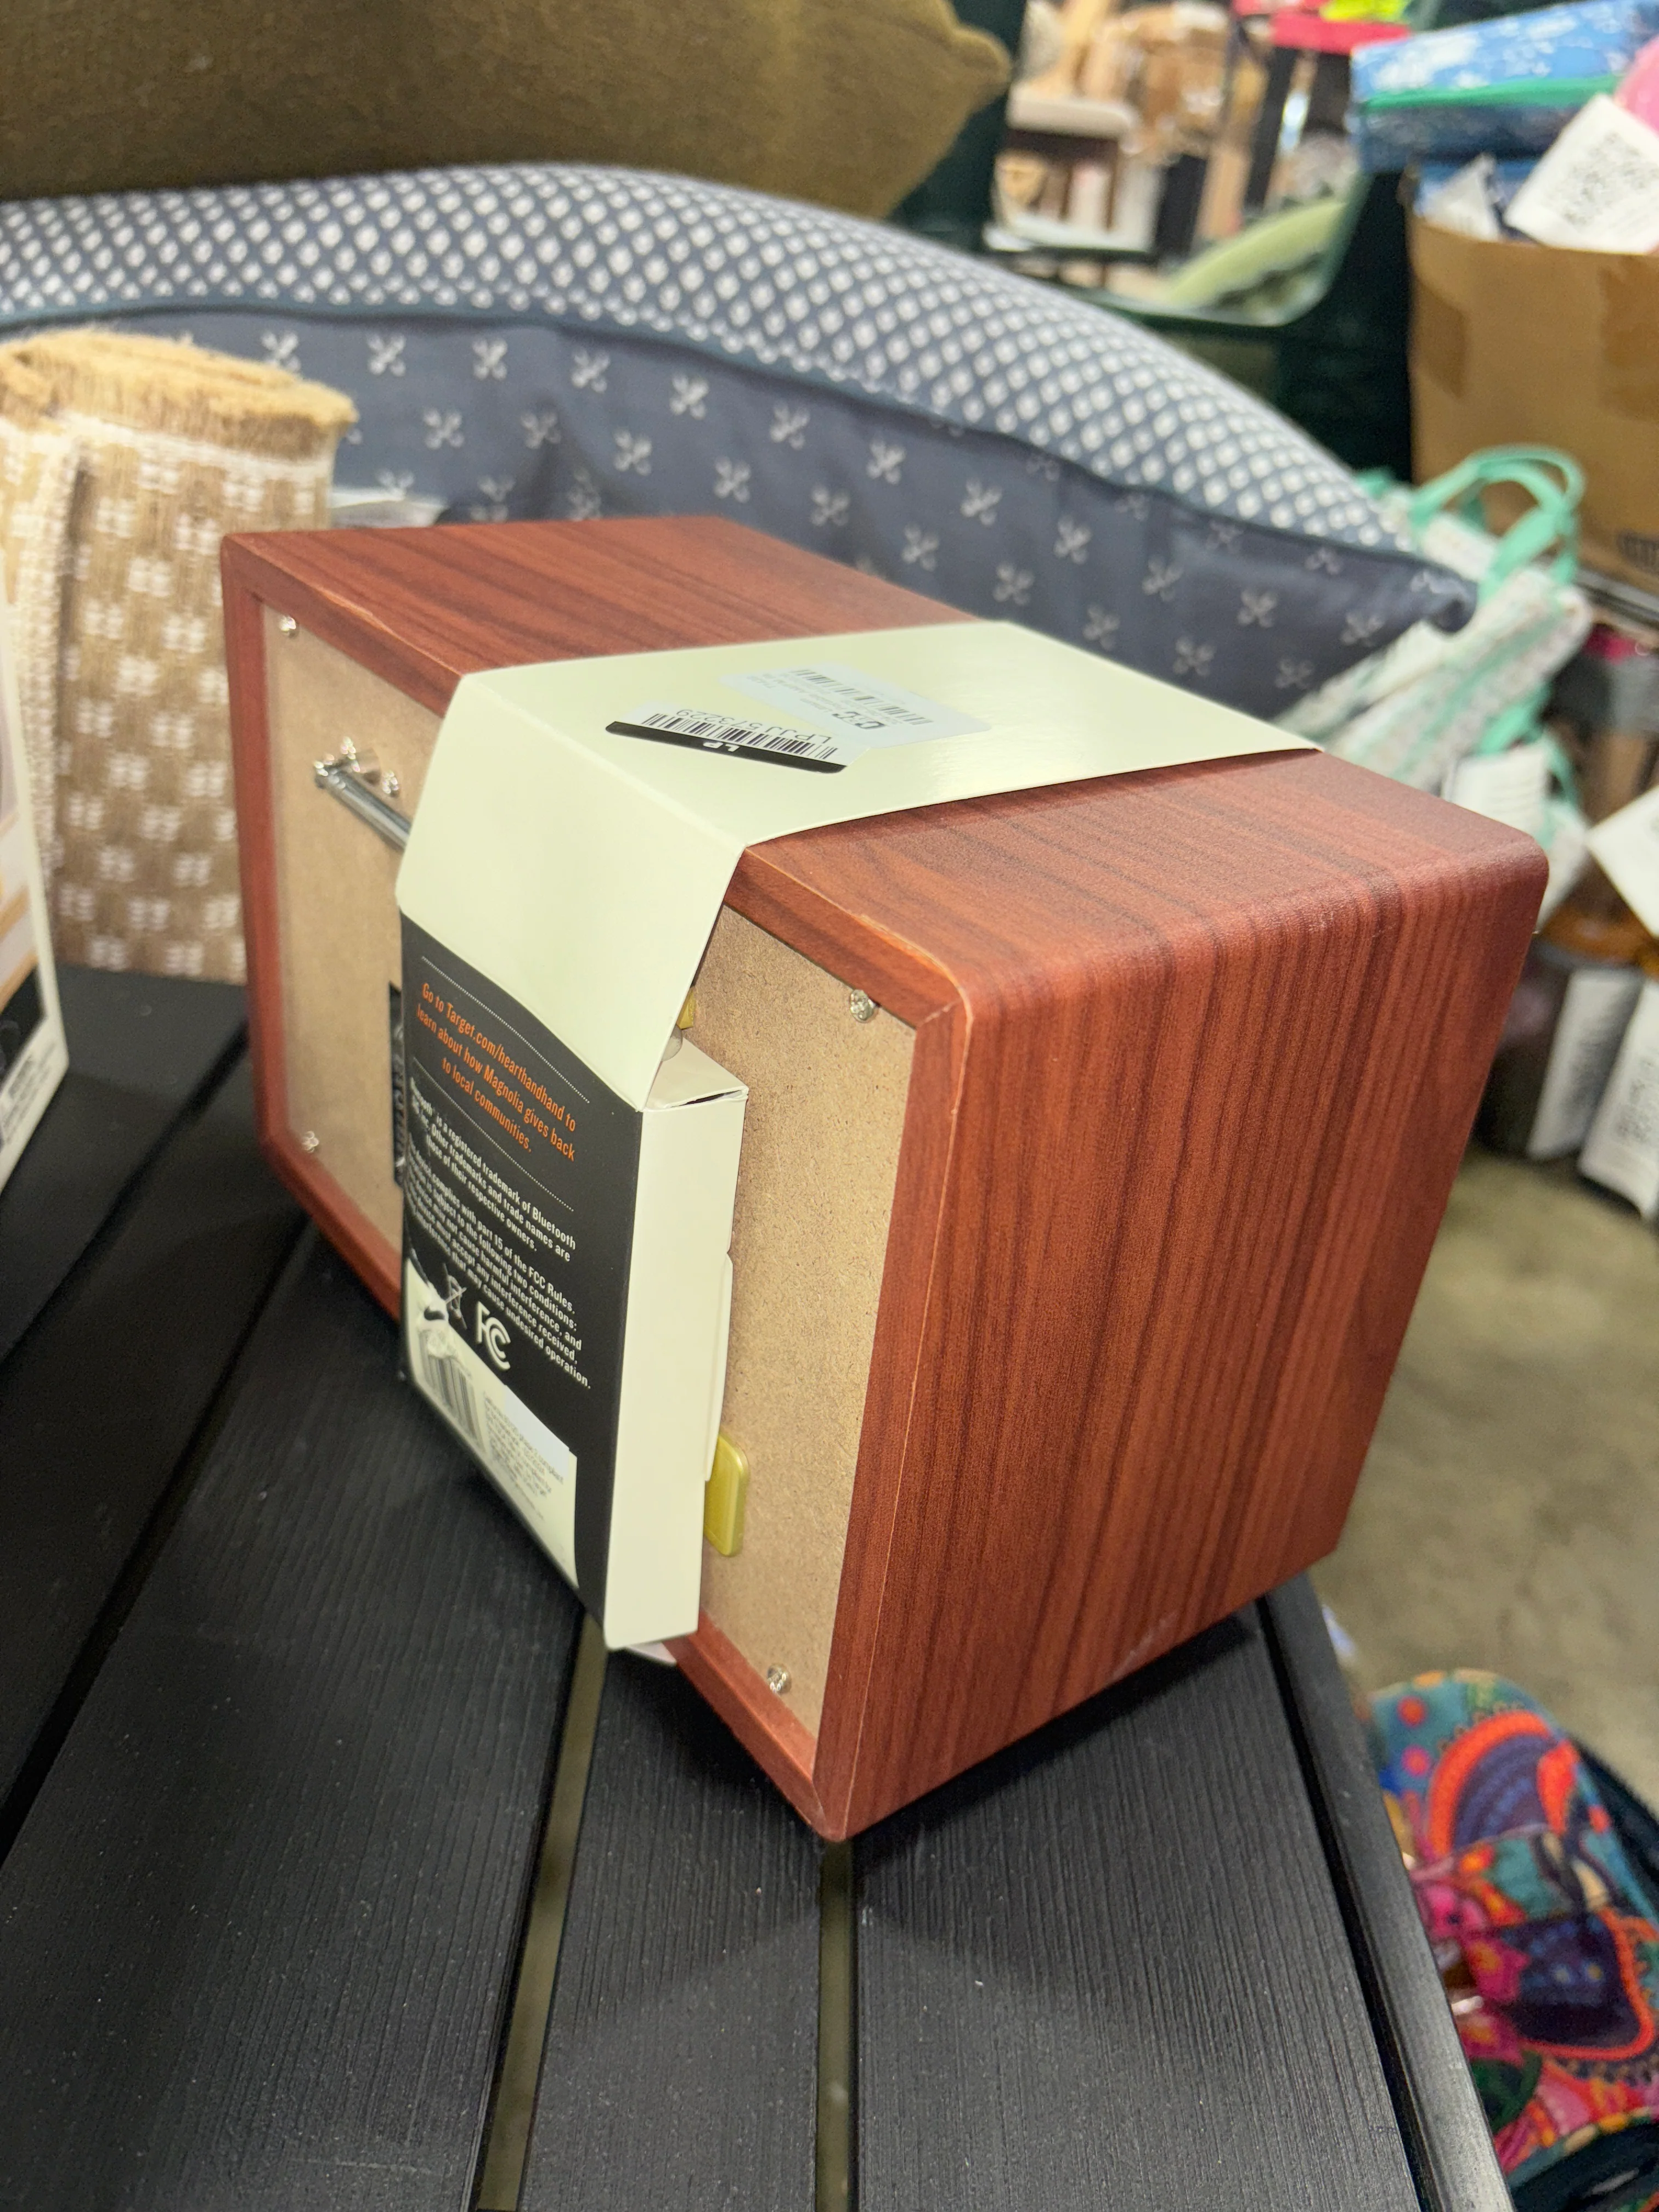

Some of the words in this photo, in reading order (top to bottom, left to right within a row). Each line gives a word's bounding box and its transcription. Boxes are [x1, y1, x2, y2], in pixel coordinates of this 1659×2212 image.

[703, 742, 740, 752] LP
[416, 1003, 437, 1034] learn
[437, 1028, 463, 1057] about
[464, 1047, 483, 1074] how
[483, 1064, 524, 1113] Magnolia
[524, 1108, 549, 1137] gives
[550, 1127, 575, 1162] back
[422, 983, 433, 1003] Go
[435, 996, 444, 1013] to
[446, 1002, 565, 1120] Target.com/hearthandhand
[565, 1113, 575, 1132] to
[442, 1057, 451, 1074] to
[452, 1064, 474, 1095] local
[473, 1090, 532, 1153] communities.
[449, 1144, 487, 1189] trademarks
[488, 1184, 502, 1204] and
[503, 1198, 524, 1224] trade
[525, 1220, 553, 1249] names
[555, 1244, 571, 1262] are
[467, 1181, 505, 1222] respective
[506, 1218, 537, 1252] owners.
[482, 1163, 521, 1205] trademark
[522, 1200, 531, 1214] of
[532, 1206, 575, 1250] Bluetooth
[477, 1220, 493, 1240] part
[494, 1234, 503, 1250] 15
[504, 1246, 512, 1260] of
[513, 1254, 527, 1272] the
[528, 1266, 545, 1289] FCC
[547, 1283, 575, 1314] Rules.
[478, 1234, 512, 1277] following
[513, 1268, 528, 1289] two
[528, 1285, 577, 1331] conditions:
[480, 1250, 509, 1286] harmful
[509, 1279, 562, 1337] interference,
[564, 1331, 582, 1351] and
[482, 1284, 505, 1311] cause
[505, 1306, 544, 1350] undesired
[544, 1345, 591, 1389] operation.
[489, 1275, 537, 1327] interference
[538, 1323, 577, 1365] received,
